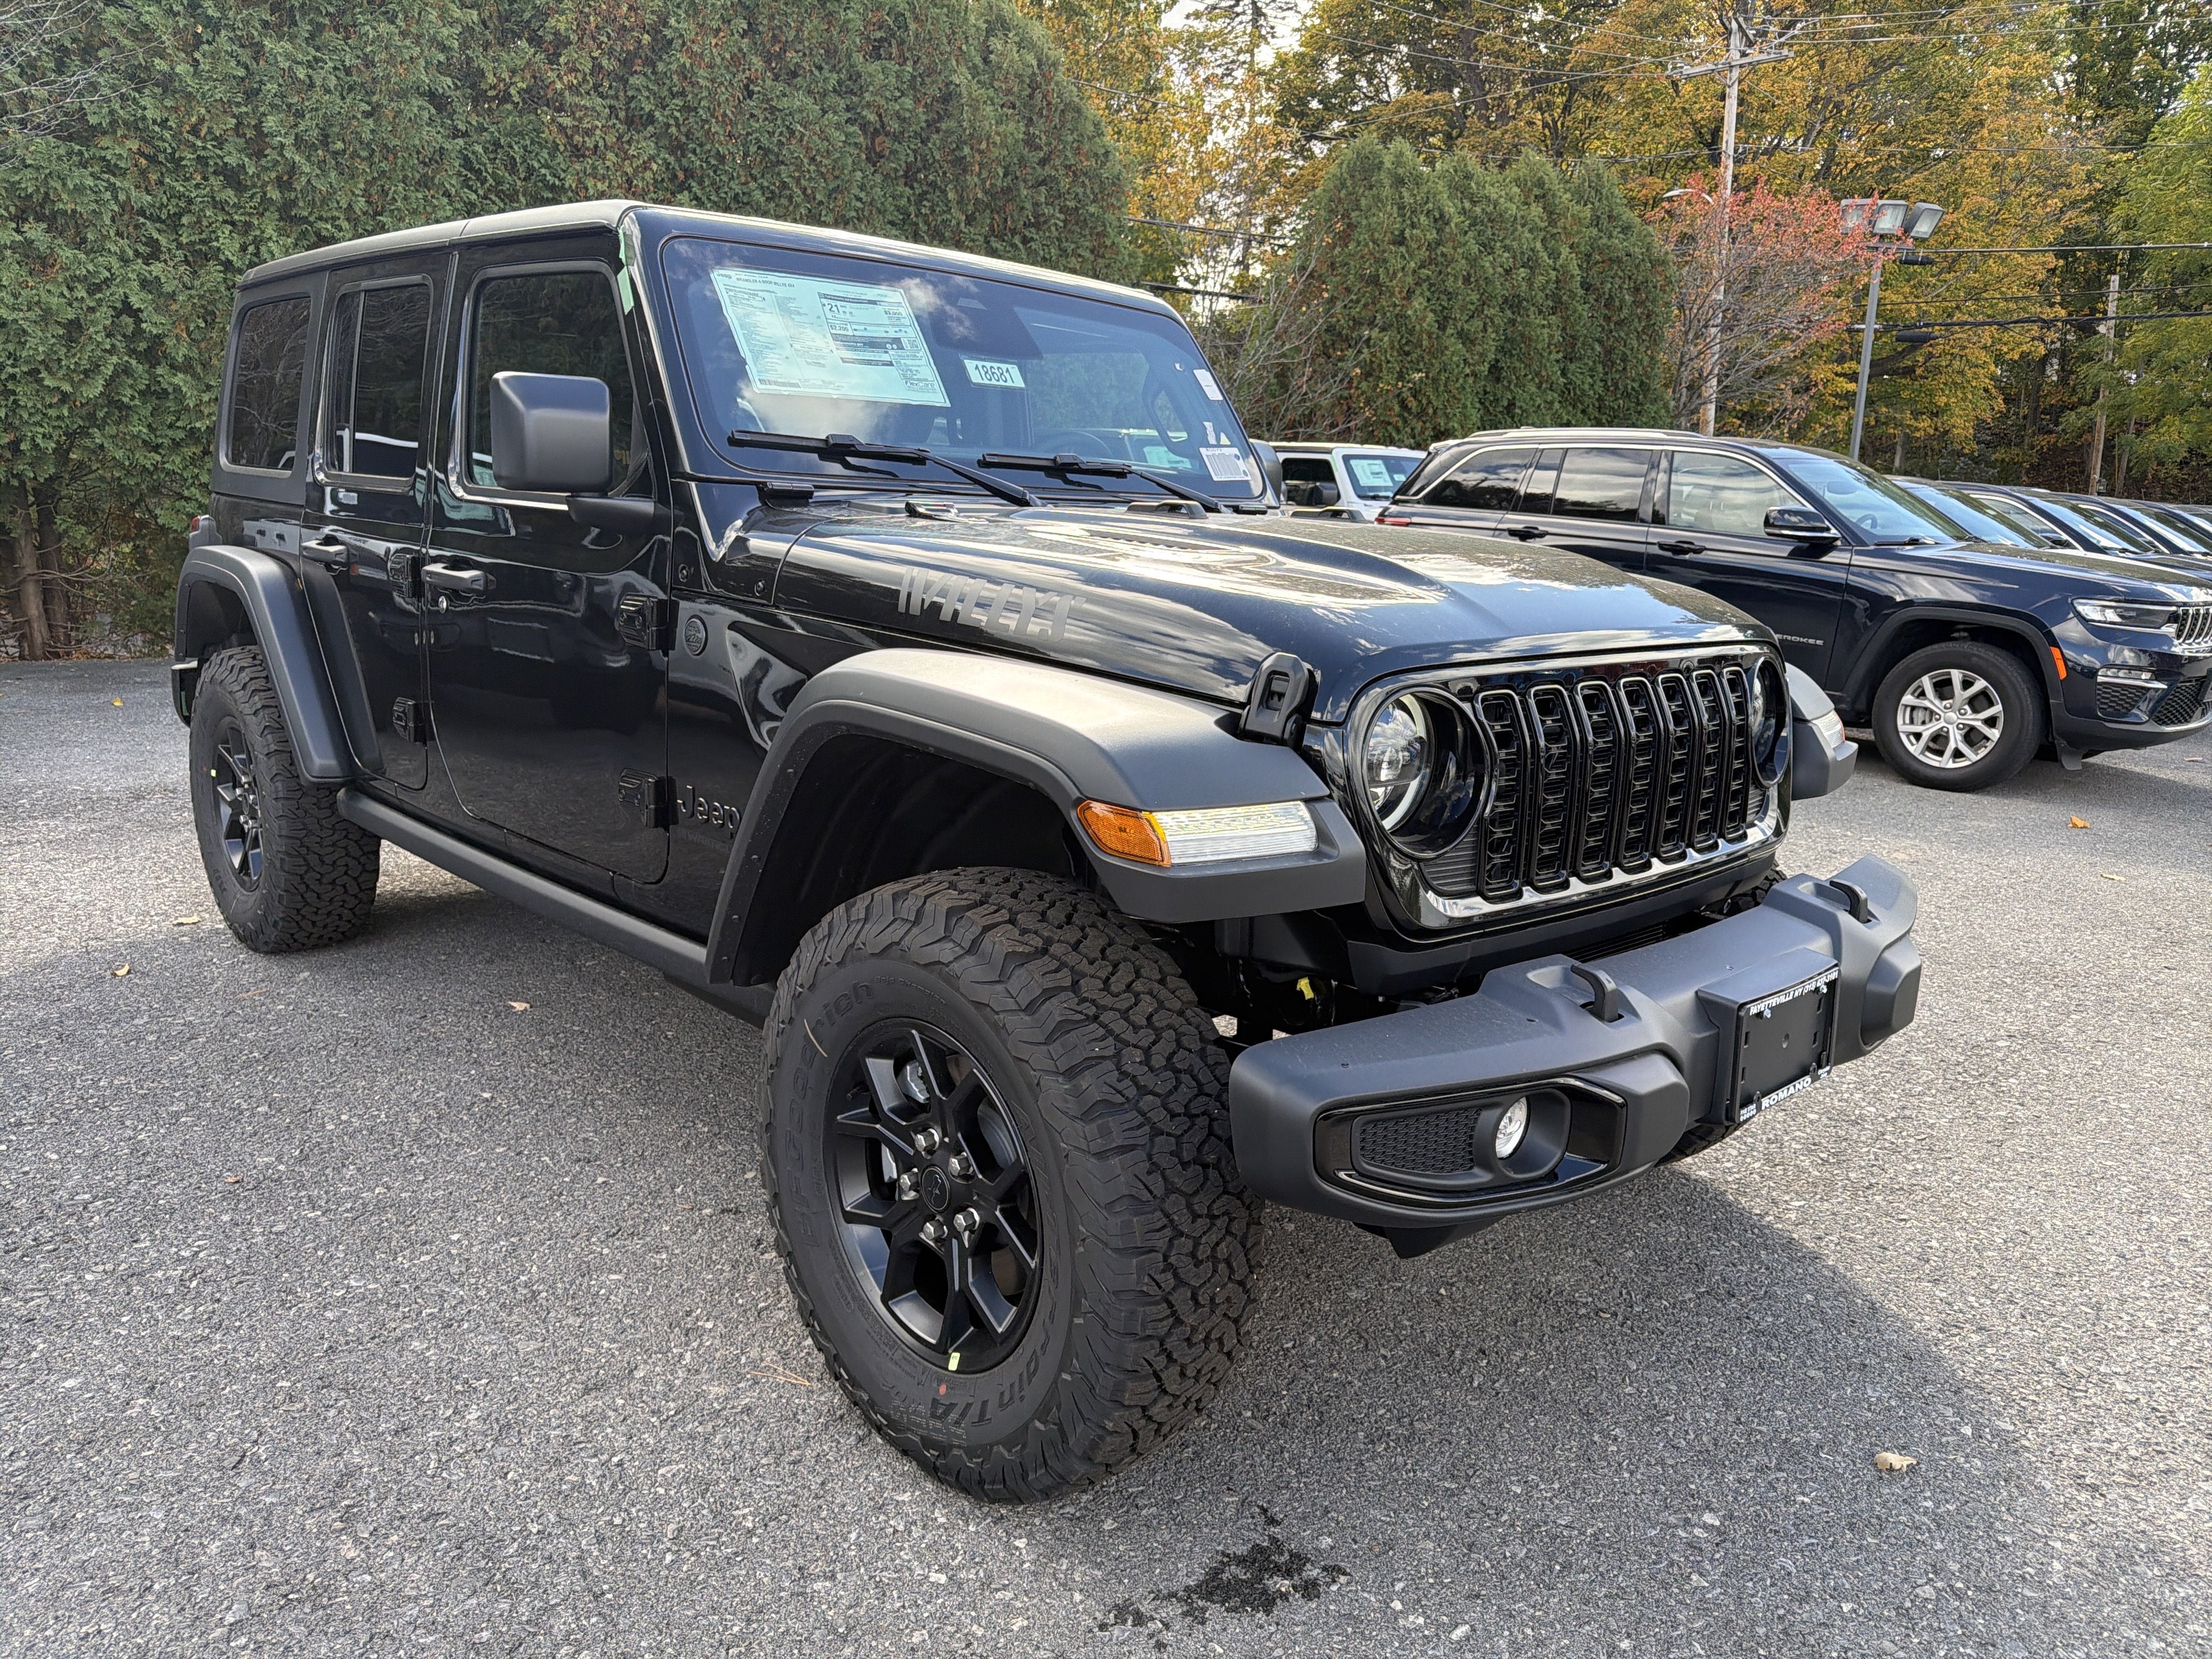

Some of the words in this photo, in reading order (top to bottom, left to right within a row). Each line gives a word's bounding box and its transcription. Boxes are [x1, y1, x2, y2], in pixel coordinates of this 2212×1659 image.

[827, 303, 840, 313] 21
[974, 364, 1015, 384] 18681
[898, 567, 1087, 643] WILLYS
[1775, 634, 1824, 646] EROKEE
[676, 785, 741, 840] Jeep
[1750, 991, 1795, 1016] FAYETTEVILLE
[1794, 987, 1804, 998] NY
[1761, 1077, 1812, 1110] ROMANO
